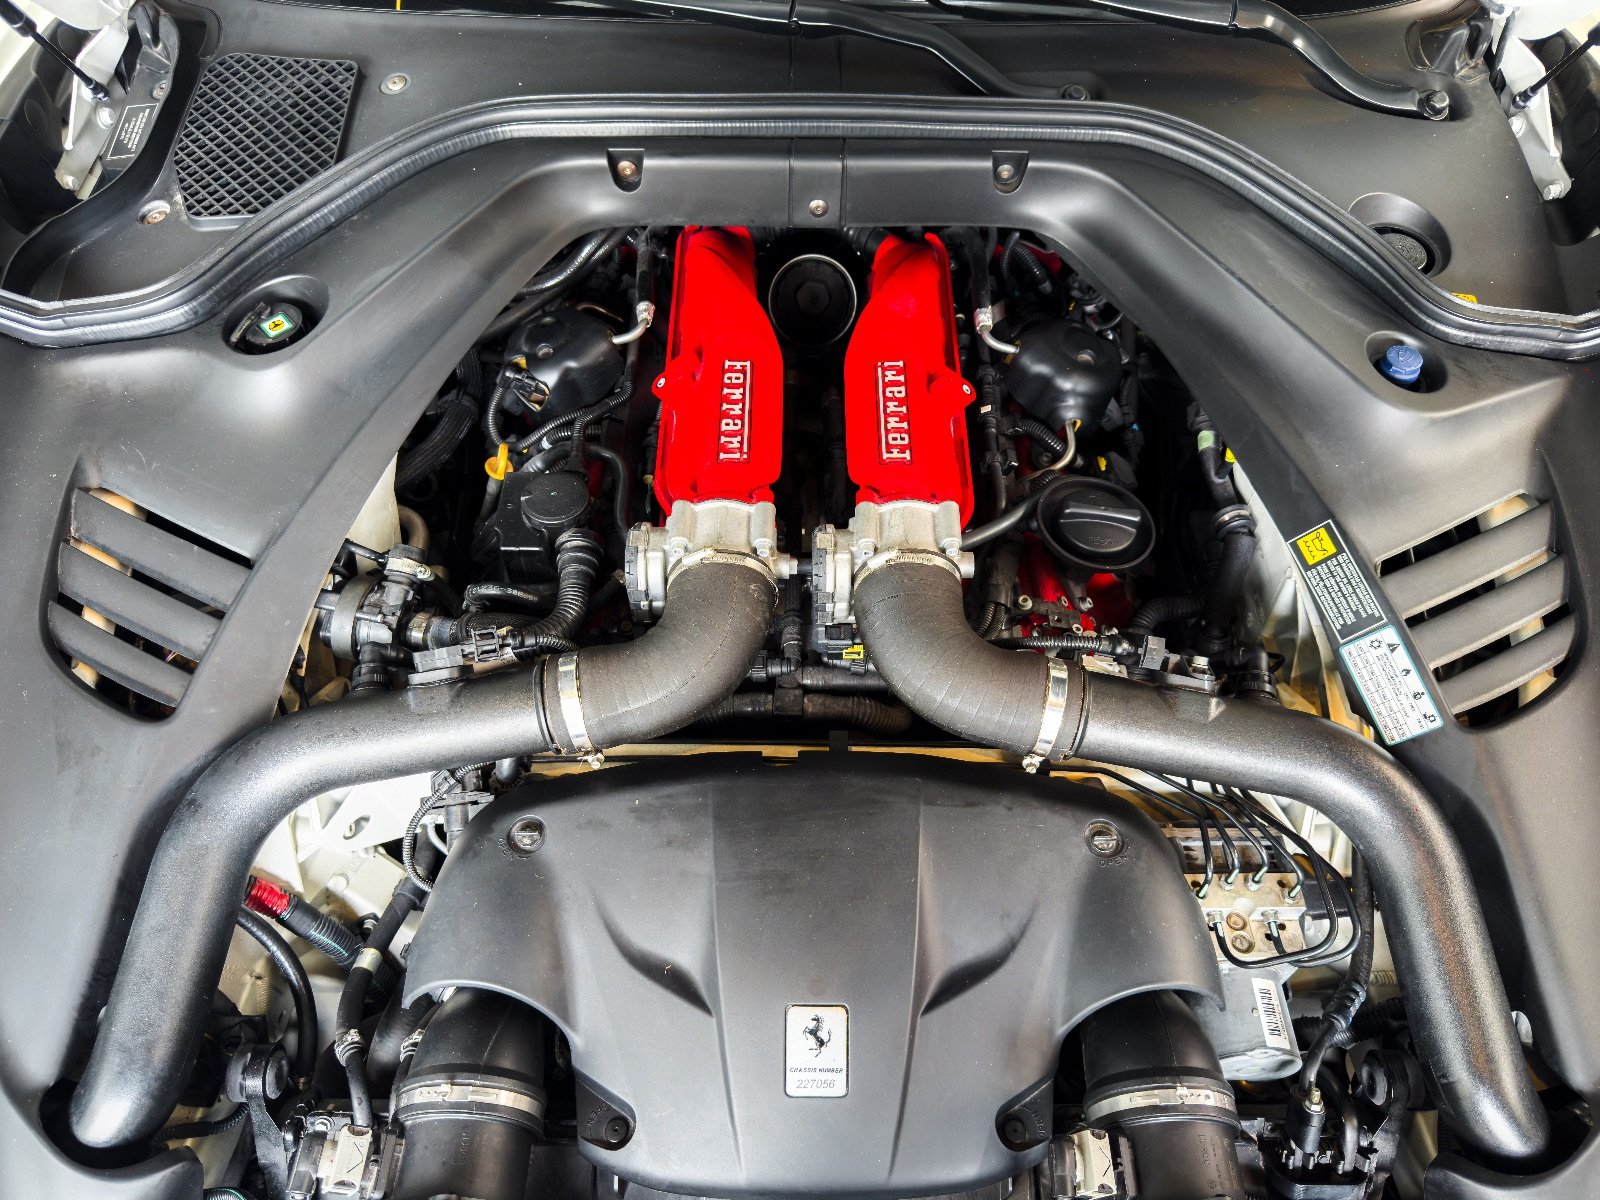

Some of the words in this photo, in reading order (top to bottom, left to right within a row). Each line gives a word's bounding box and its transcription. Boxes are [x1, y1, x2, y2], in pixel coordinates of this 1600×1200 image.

[719, 359, 751, 460] Ferrari
[877, 360, 911, 461] Ferrari
[795, 1078, 836, 1089] 227056
